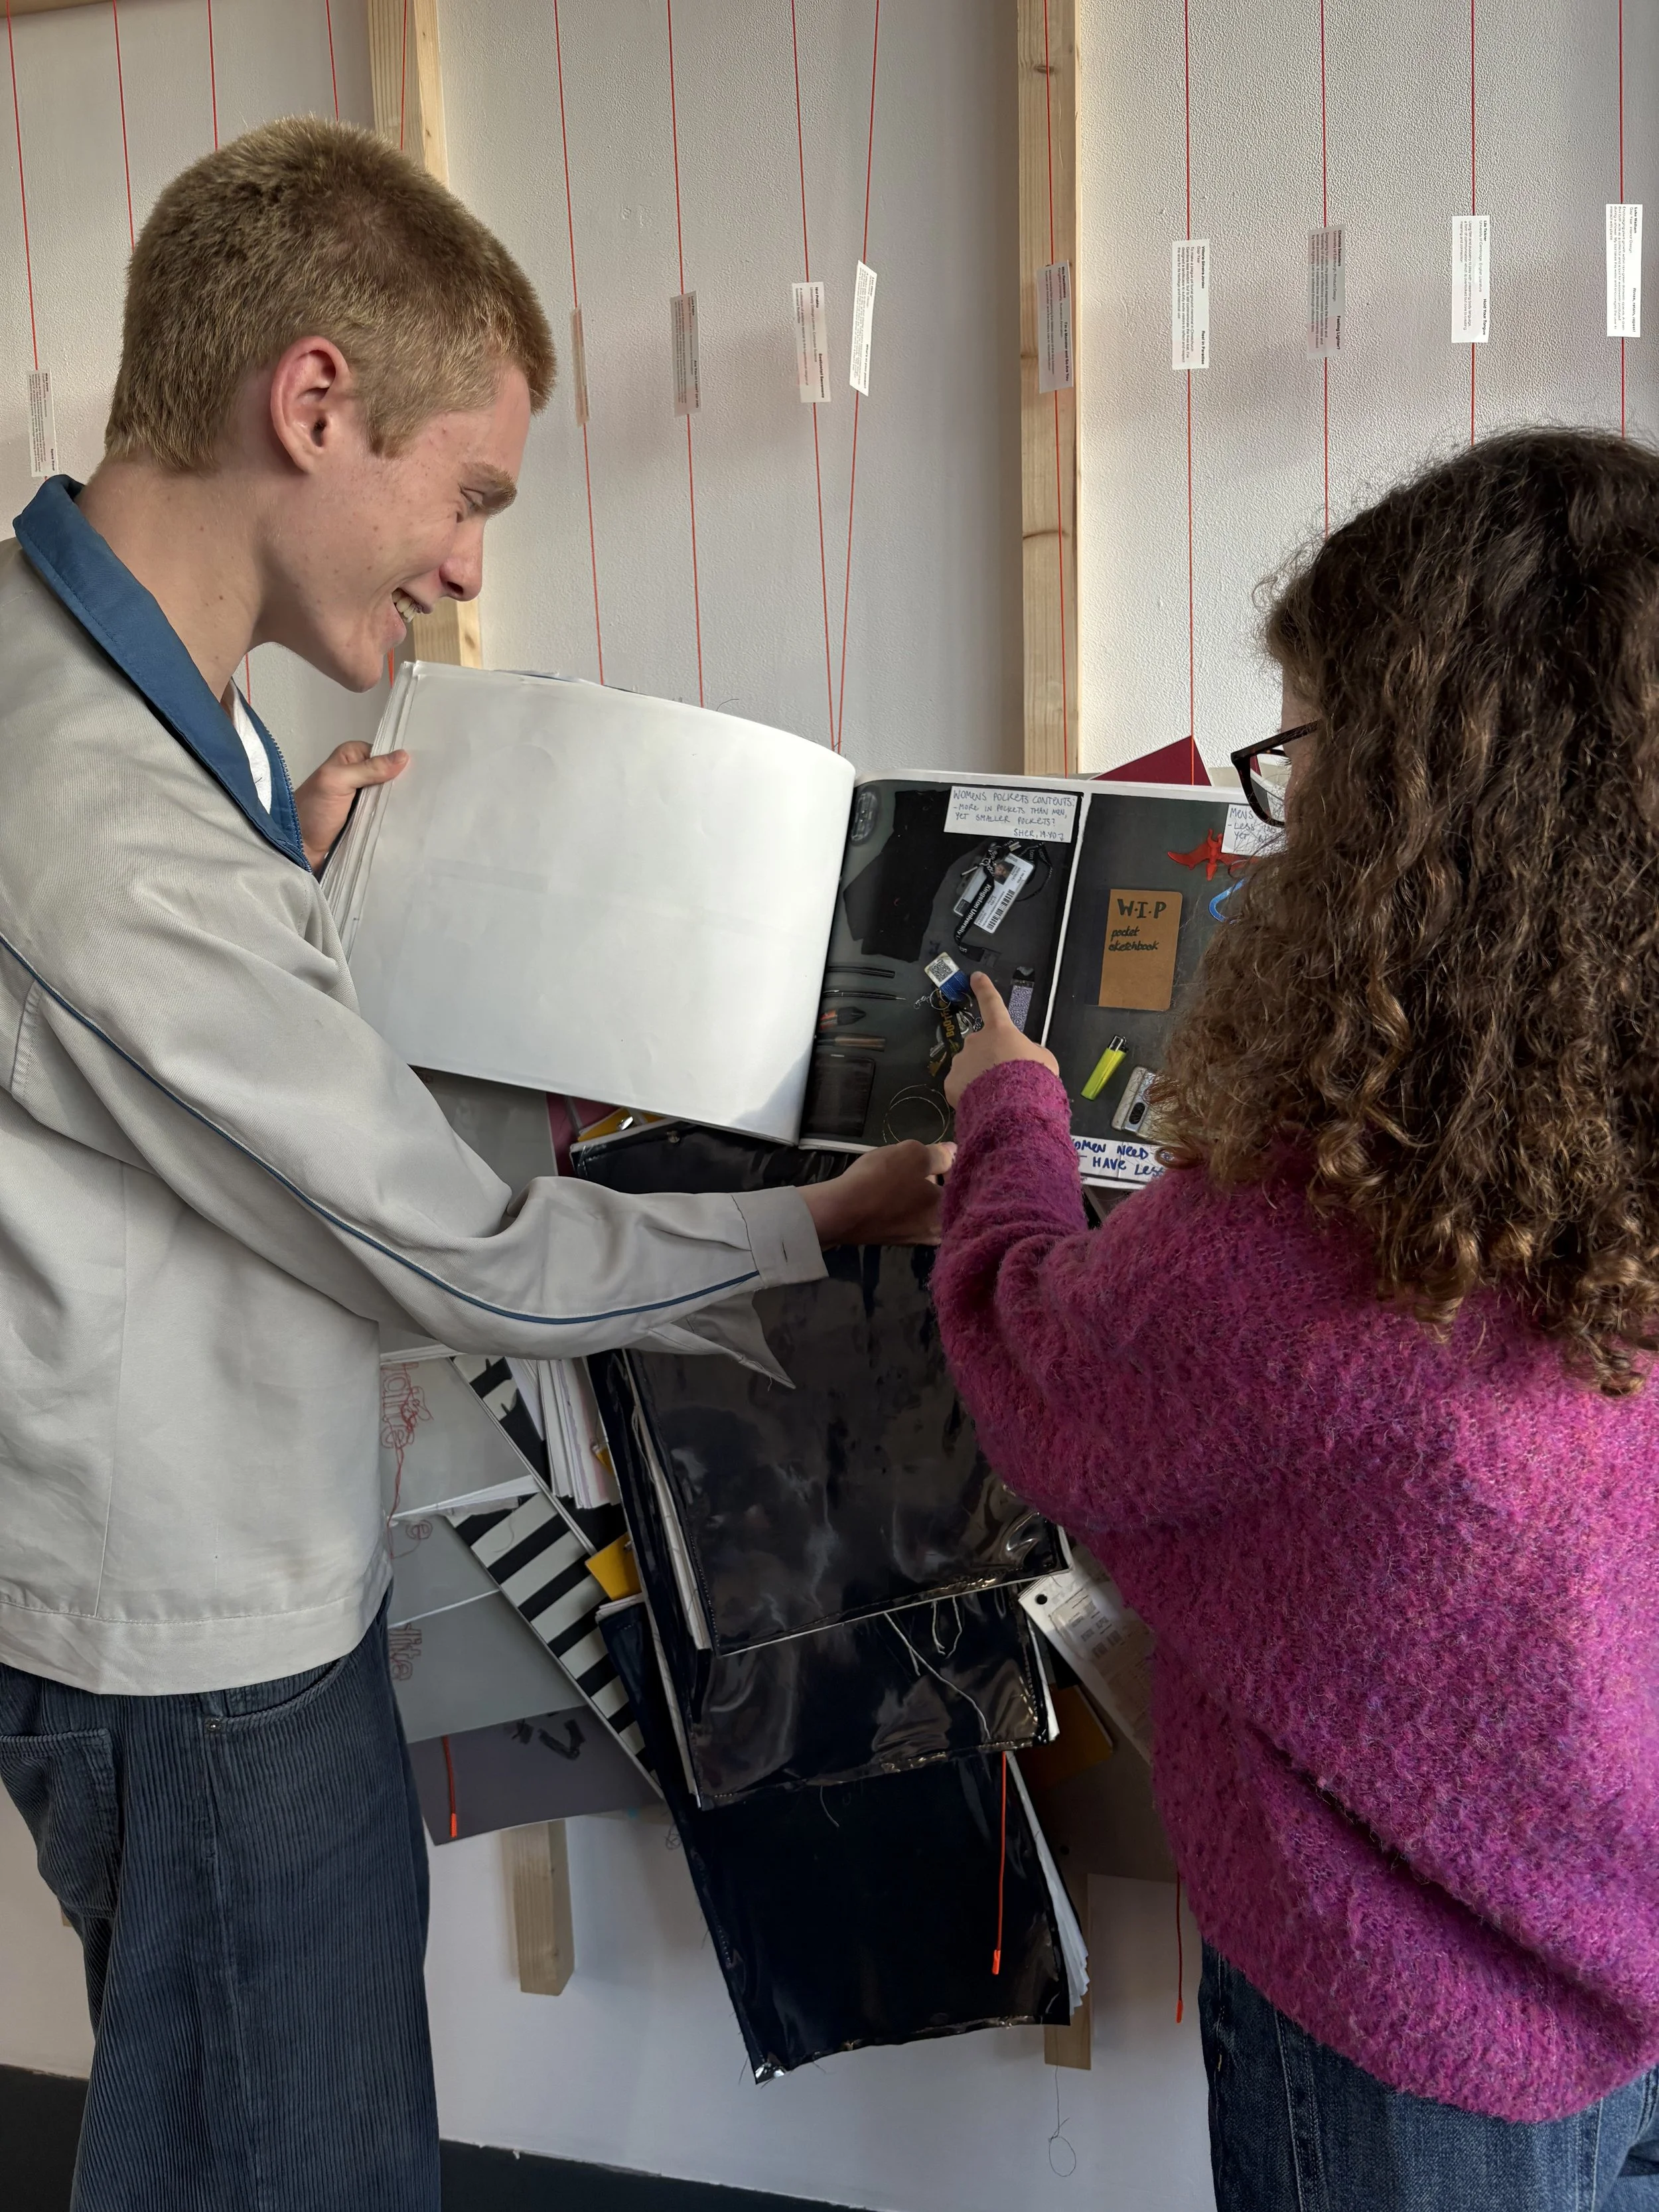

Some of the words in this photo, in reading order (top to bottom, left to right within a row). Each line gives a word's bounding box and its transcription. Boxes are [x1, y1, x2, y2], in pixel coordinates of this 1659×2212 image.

[996, 804, 1026, 814] POCKETS
[954, 812, 970, 820] YET
[975, 813, 1011, 824] SMALLER
[972, 883, 993, 911] Kingston
[956, 909, 977, 936] University
[1110, 925, 1141, 942] pocket
[1108, 940, 1160, 952] sketchbook
[1116, 1144, 1149, 1160] NEED
[1092, 1156, 1127, 1171] HAVE
